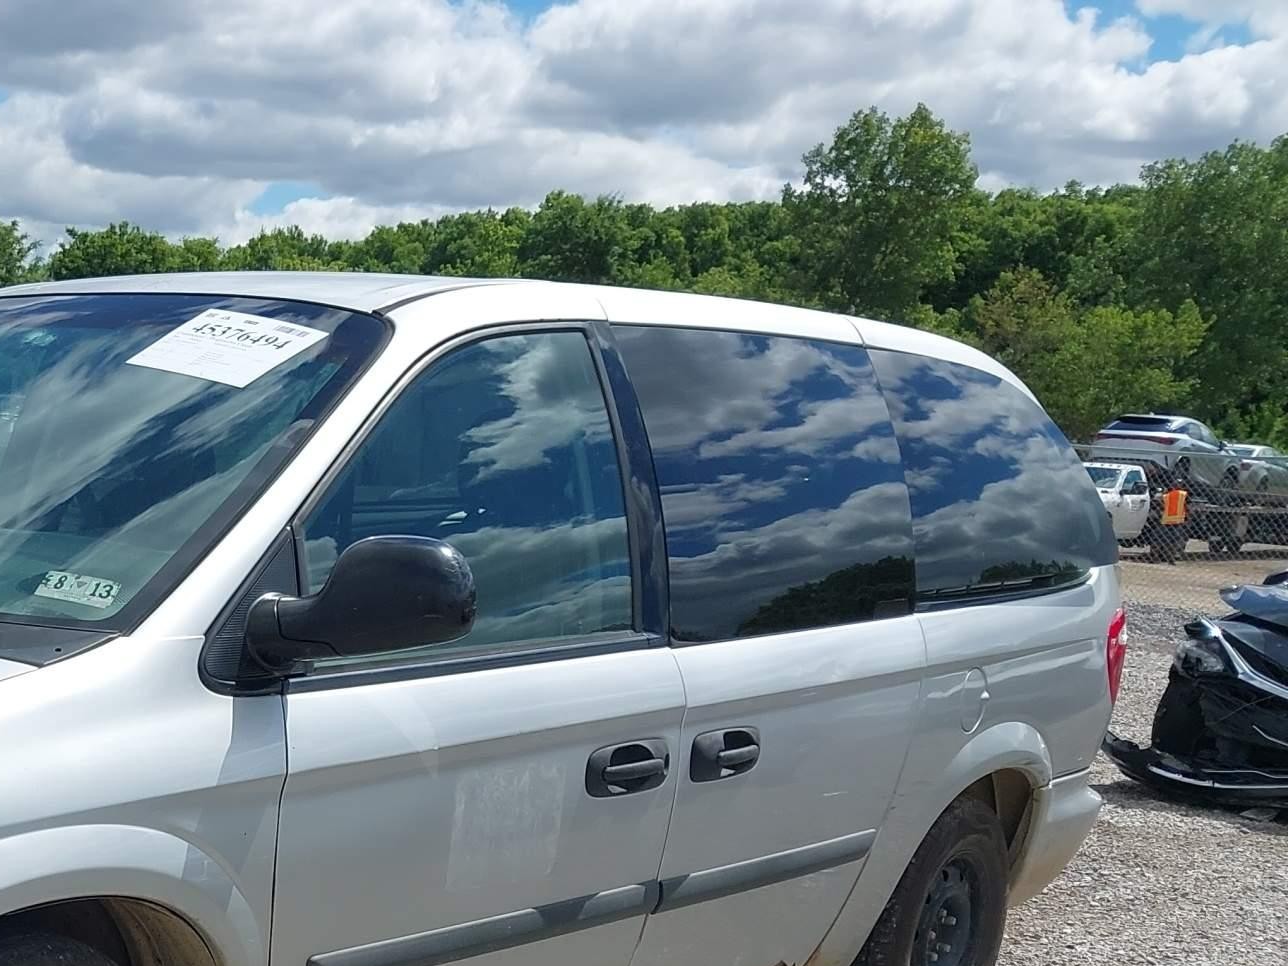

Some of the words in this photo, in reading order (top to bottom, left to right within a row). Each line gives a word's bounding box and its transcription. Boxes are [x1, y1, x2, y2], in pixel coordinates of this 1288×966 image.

[192, 322, 294, 351] 45376494
[53, 575, 68, 590] 8
[89, 582, 114, 599] 13
